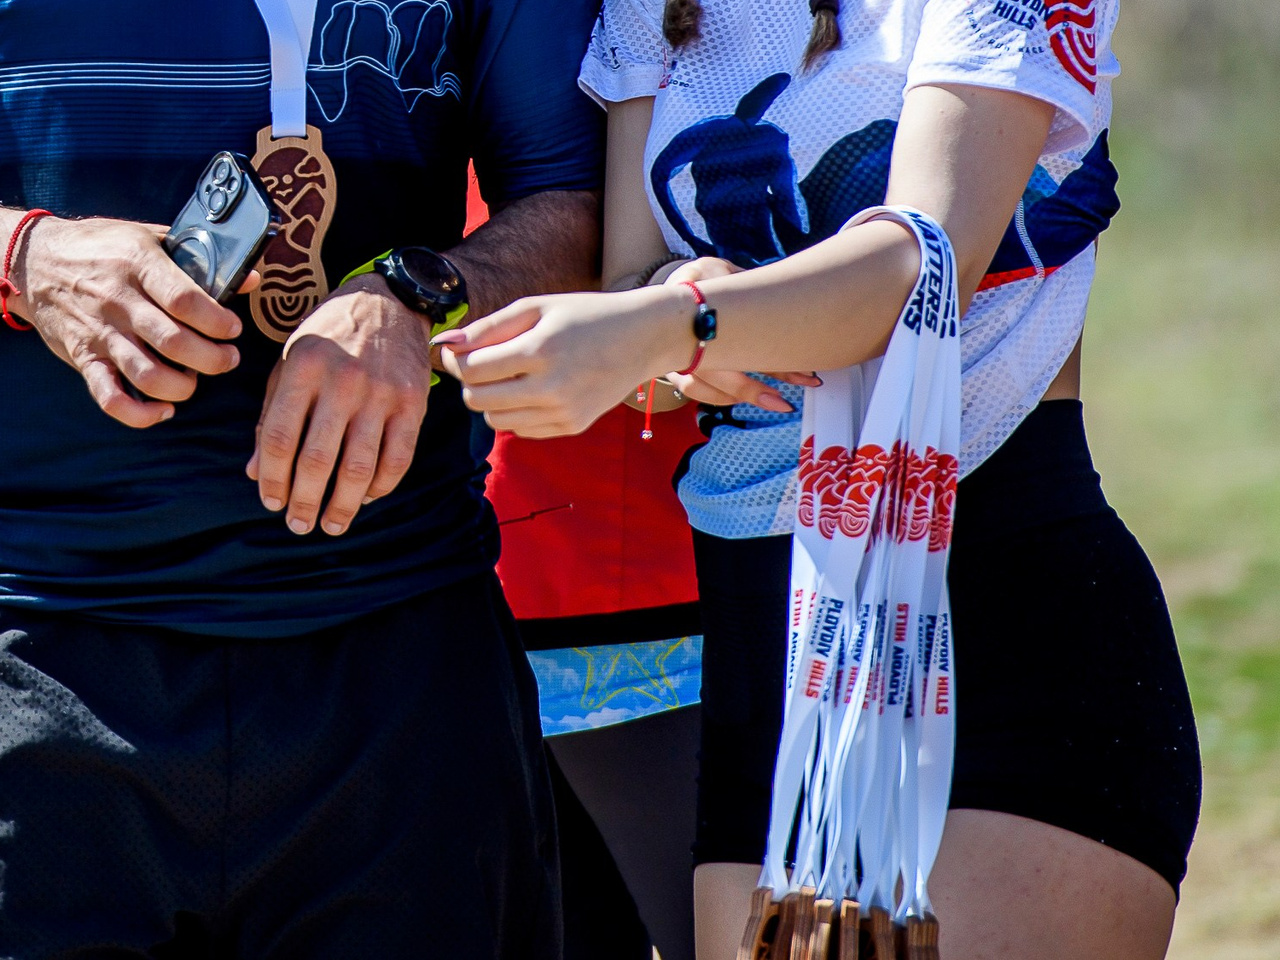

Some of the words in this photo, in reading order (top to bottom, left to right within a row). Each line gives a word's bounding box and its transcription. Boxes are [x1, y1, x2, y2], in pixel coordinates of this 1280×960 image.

[992, 0, 1037, 30] HILLS
[901, 211, 943, 333] MATTERS
[815, 598, 844, 658] PLOVDIV
[895, 603, 909, 642] HILLS
[805, 659, 827, 699] HILLS
[887, 645, 905, 705] PLOVDIV
[935, 676, 949, 715] HILLS
